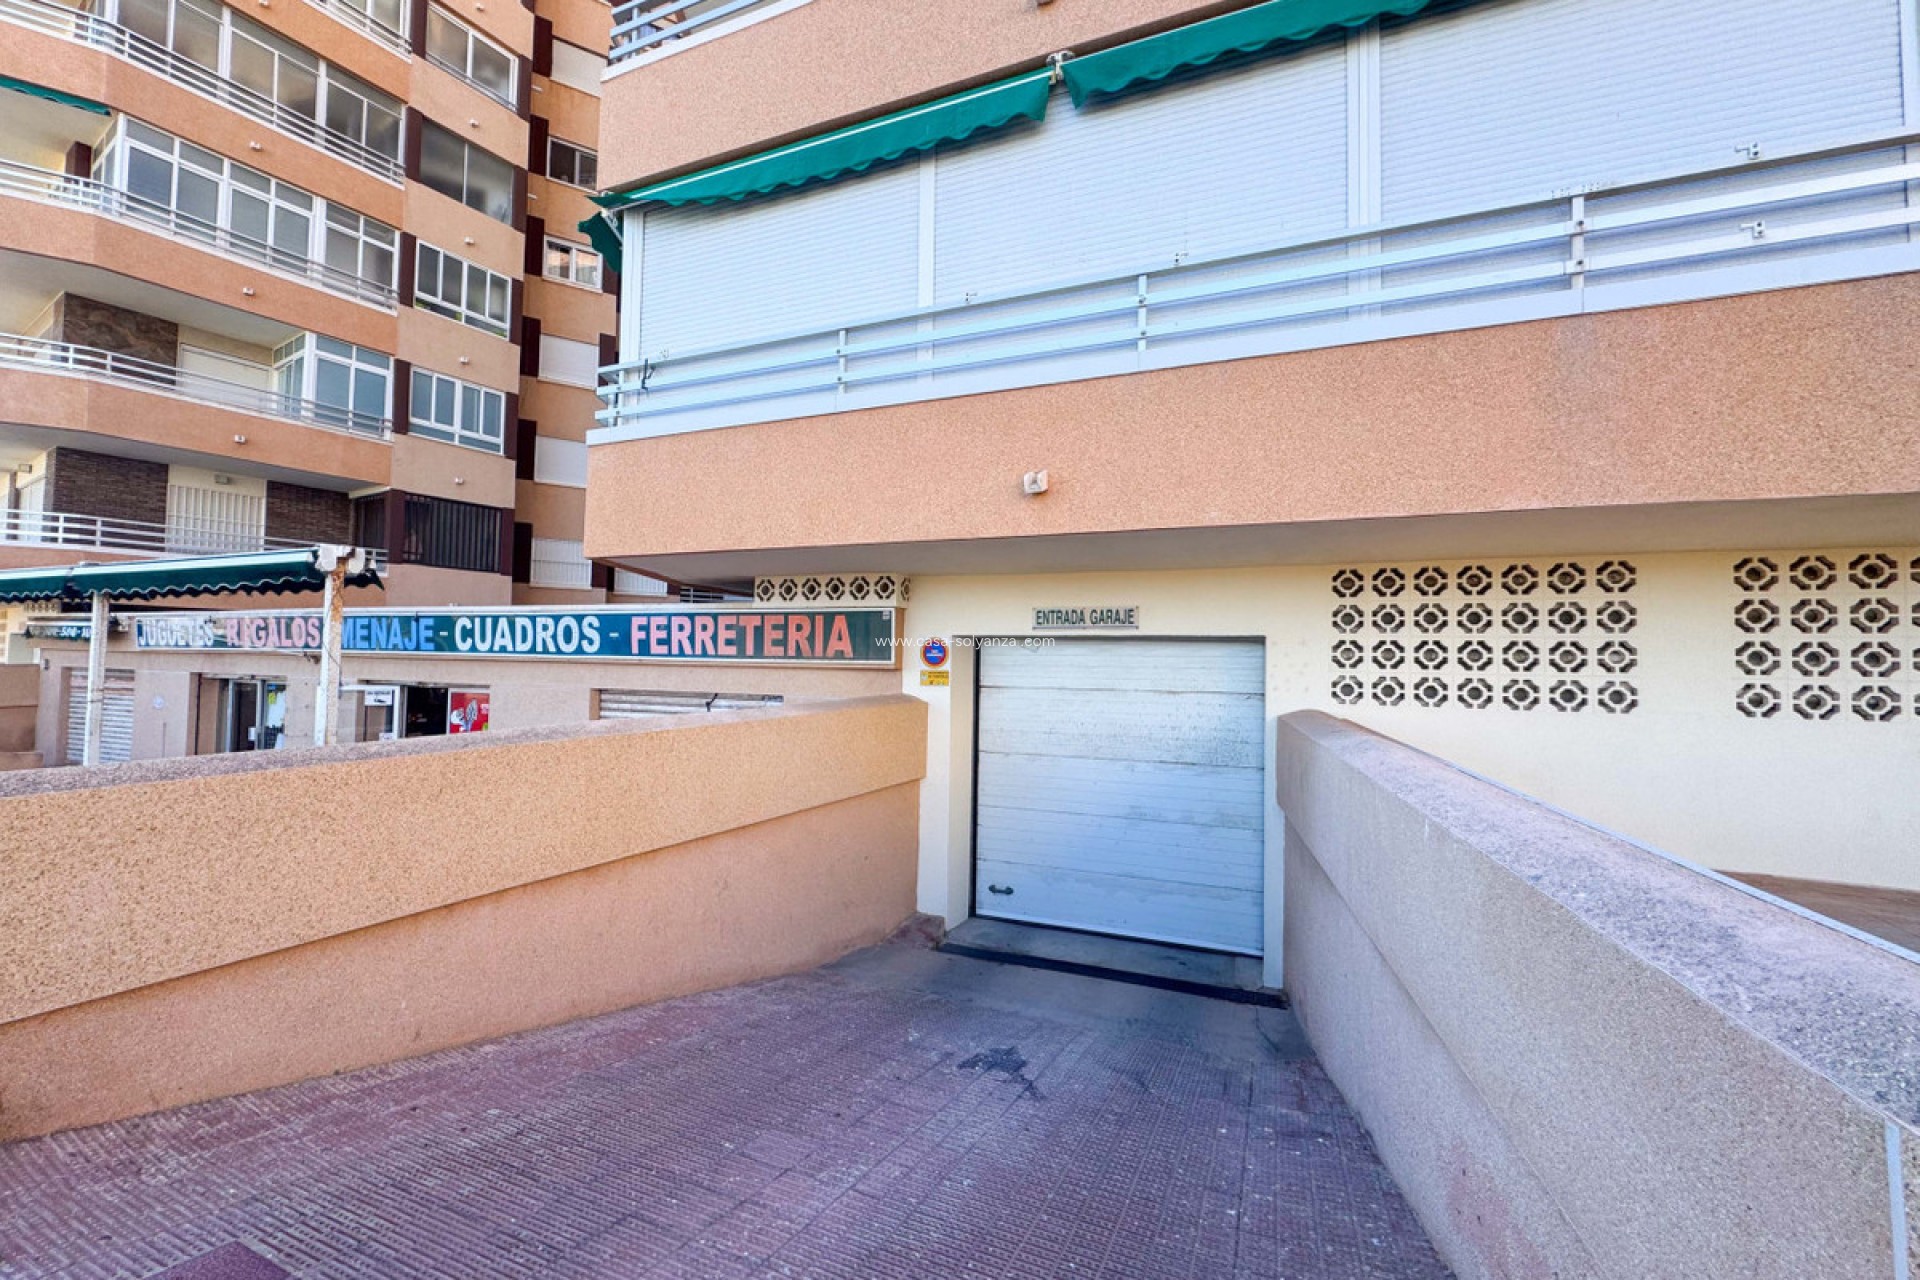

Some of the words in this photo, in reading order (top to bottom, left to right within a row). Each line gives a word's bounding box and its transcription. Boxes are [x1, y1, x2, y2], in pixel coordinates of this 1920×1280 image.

[1036, 609, 1086, 626] ENTRADA
[1089, 608, 1135, 625] GARAJE
[225, 617, 320, 648] REGALOS
[454, 616, 601, 654] CUADROS
[630, 614, 854, 658] FERRETERIA
